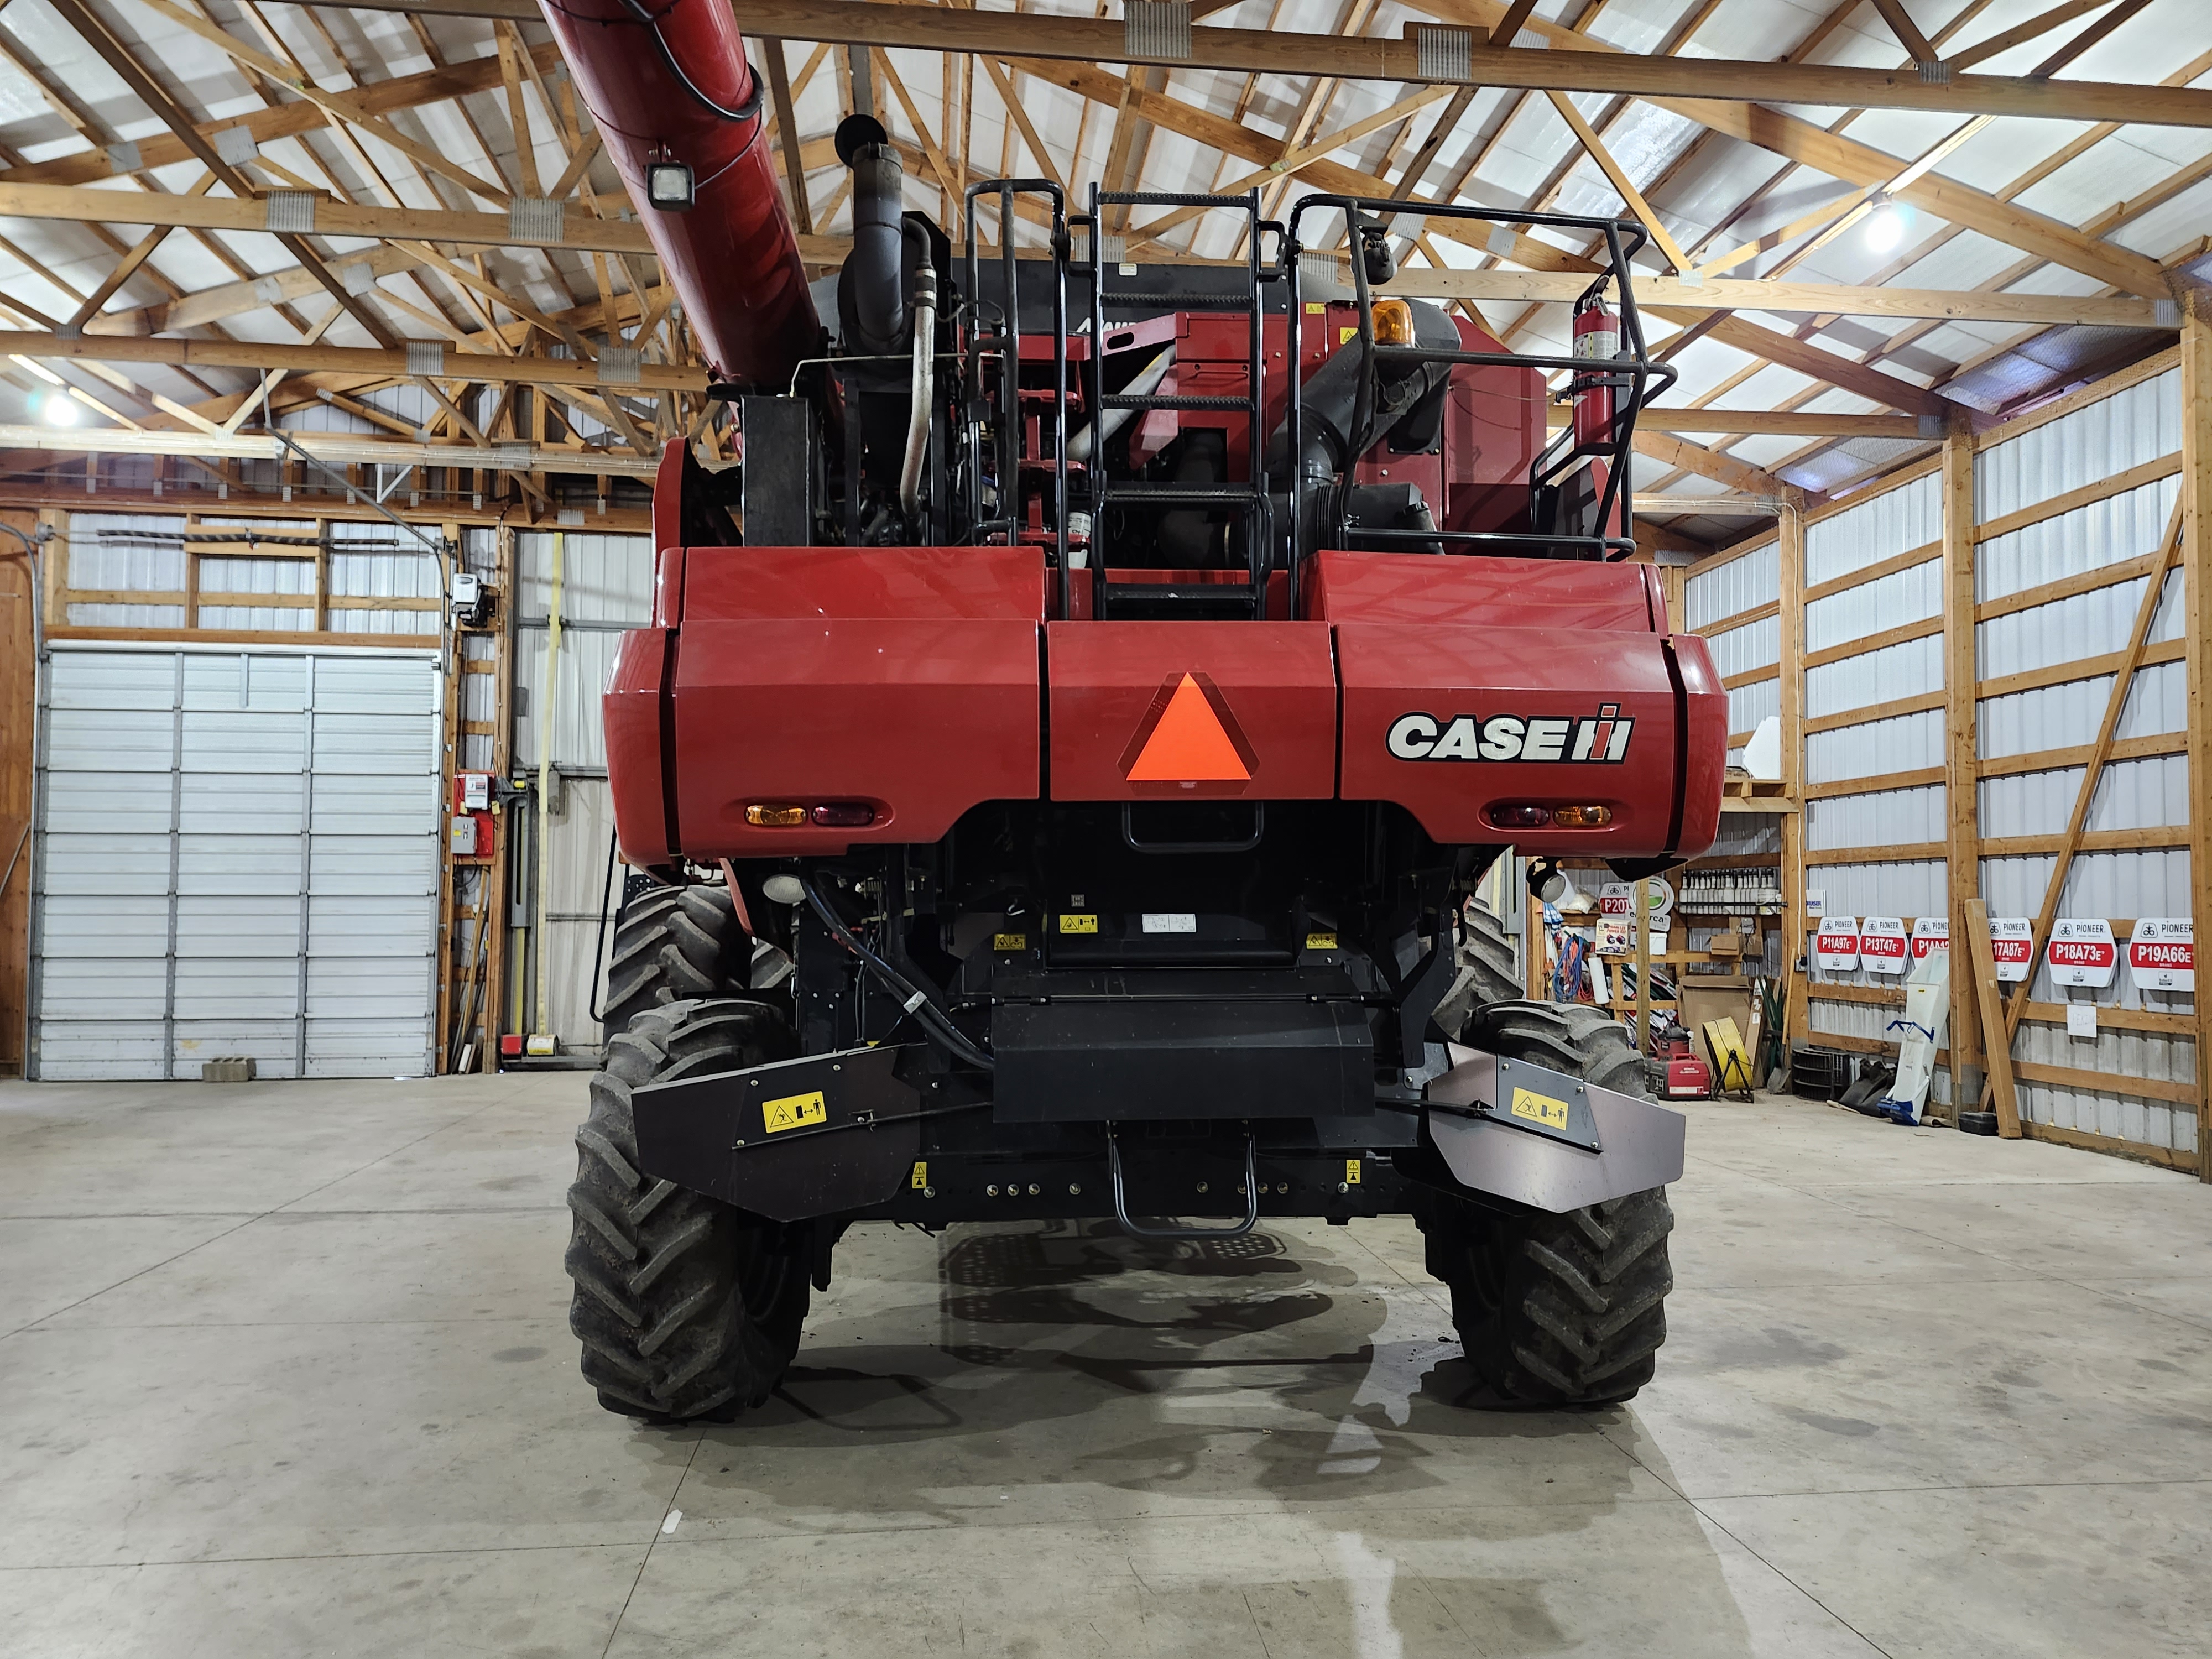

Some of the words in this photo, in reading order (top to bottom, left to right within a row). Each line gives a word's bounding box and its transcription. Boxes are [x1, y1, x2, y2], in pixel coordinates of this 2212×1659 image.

[1389, 715, 1569, 760] CASE
[1605, 899, 1629, 912] P20T
[1629, 911, 1664, 923] erca
[1834, 920, 1853, 928] PIONEER
[1879, 920, 1899, 930] PIONEER
[1932, 920, 1949, 930] PIONE
[2003, 920, 2026, 931] PIONEER
[2076, 922, 2104, 933] PIONEER
[2161, 921, 2194, 933] PIONEER
[1994, 942, 2022, 957] 17A87E
